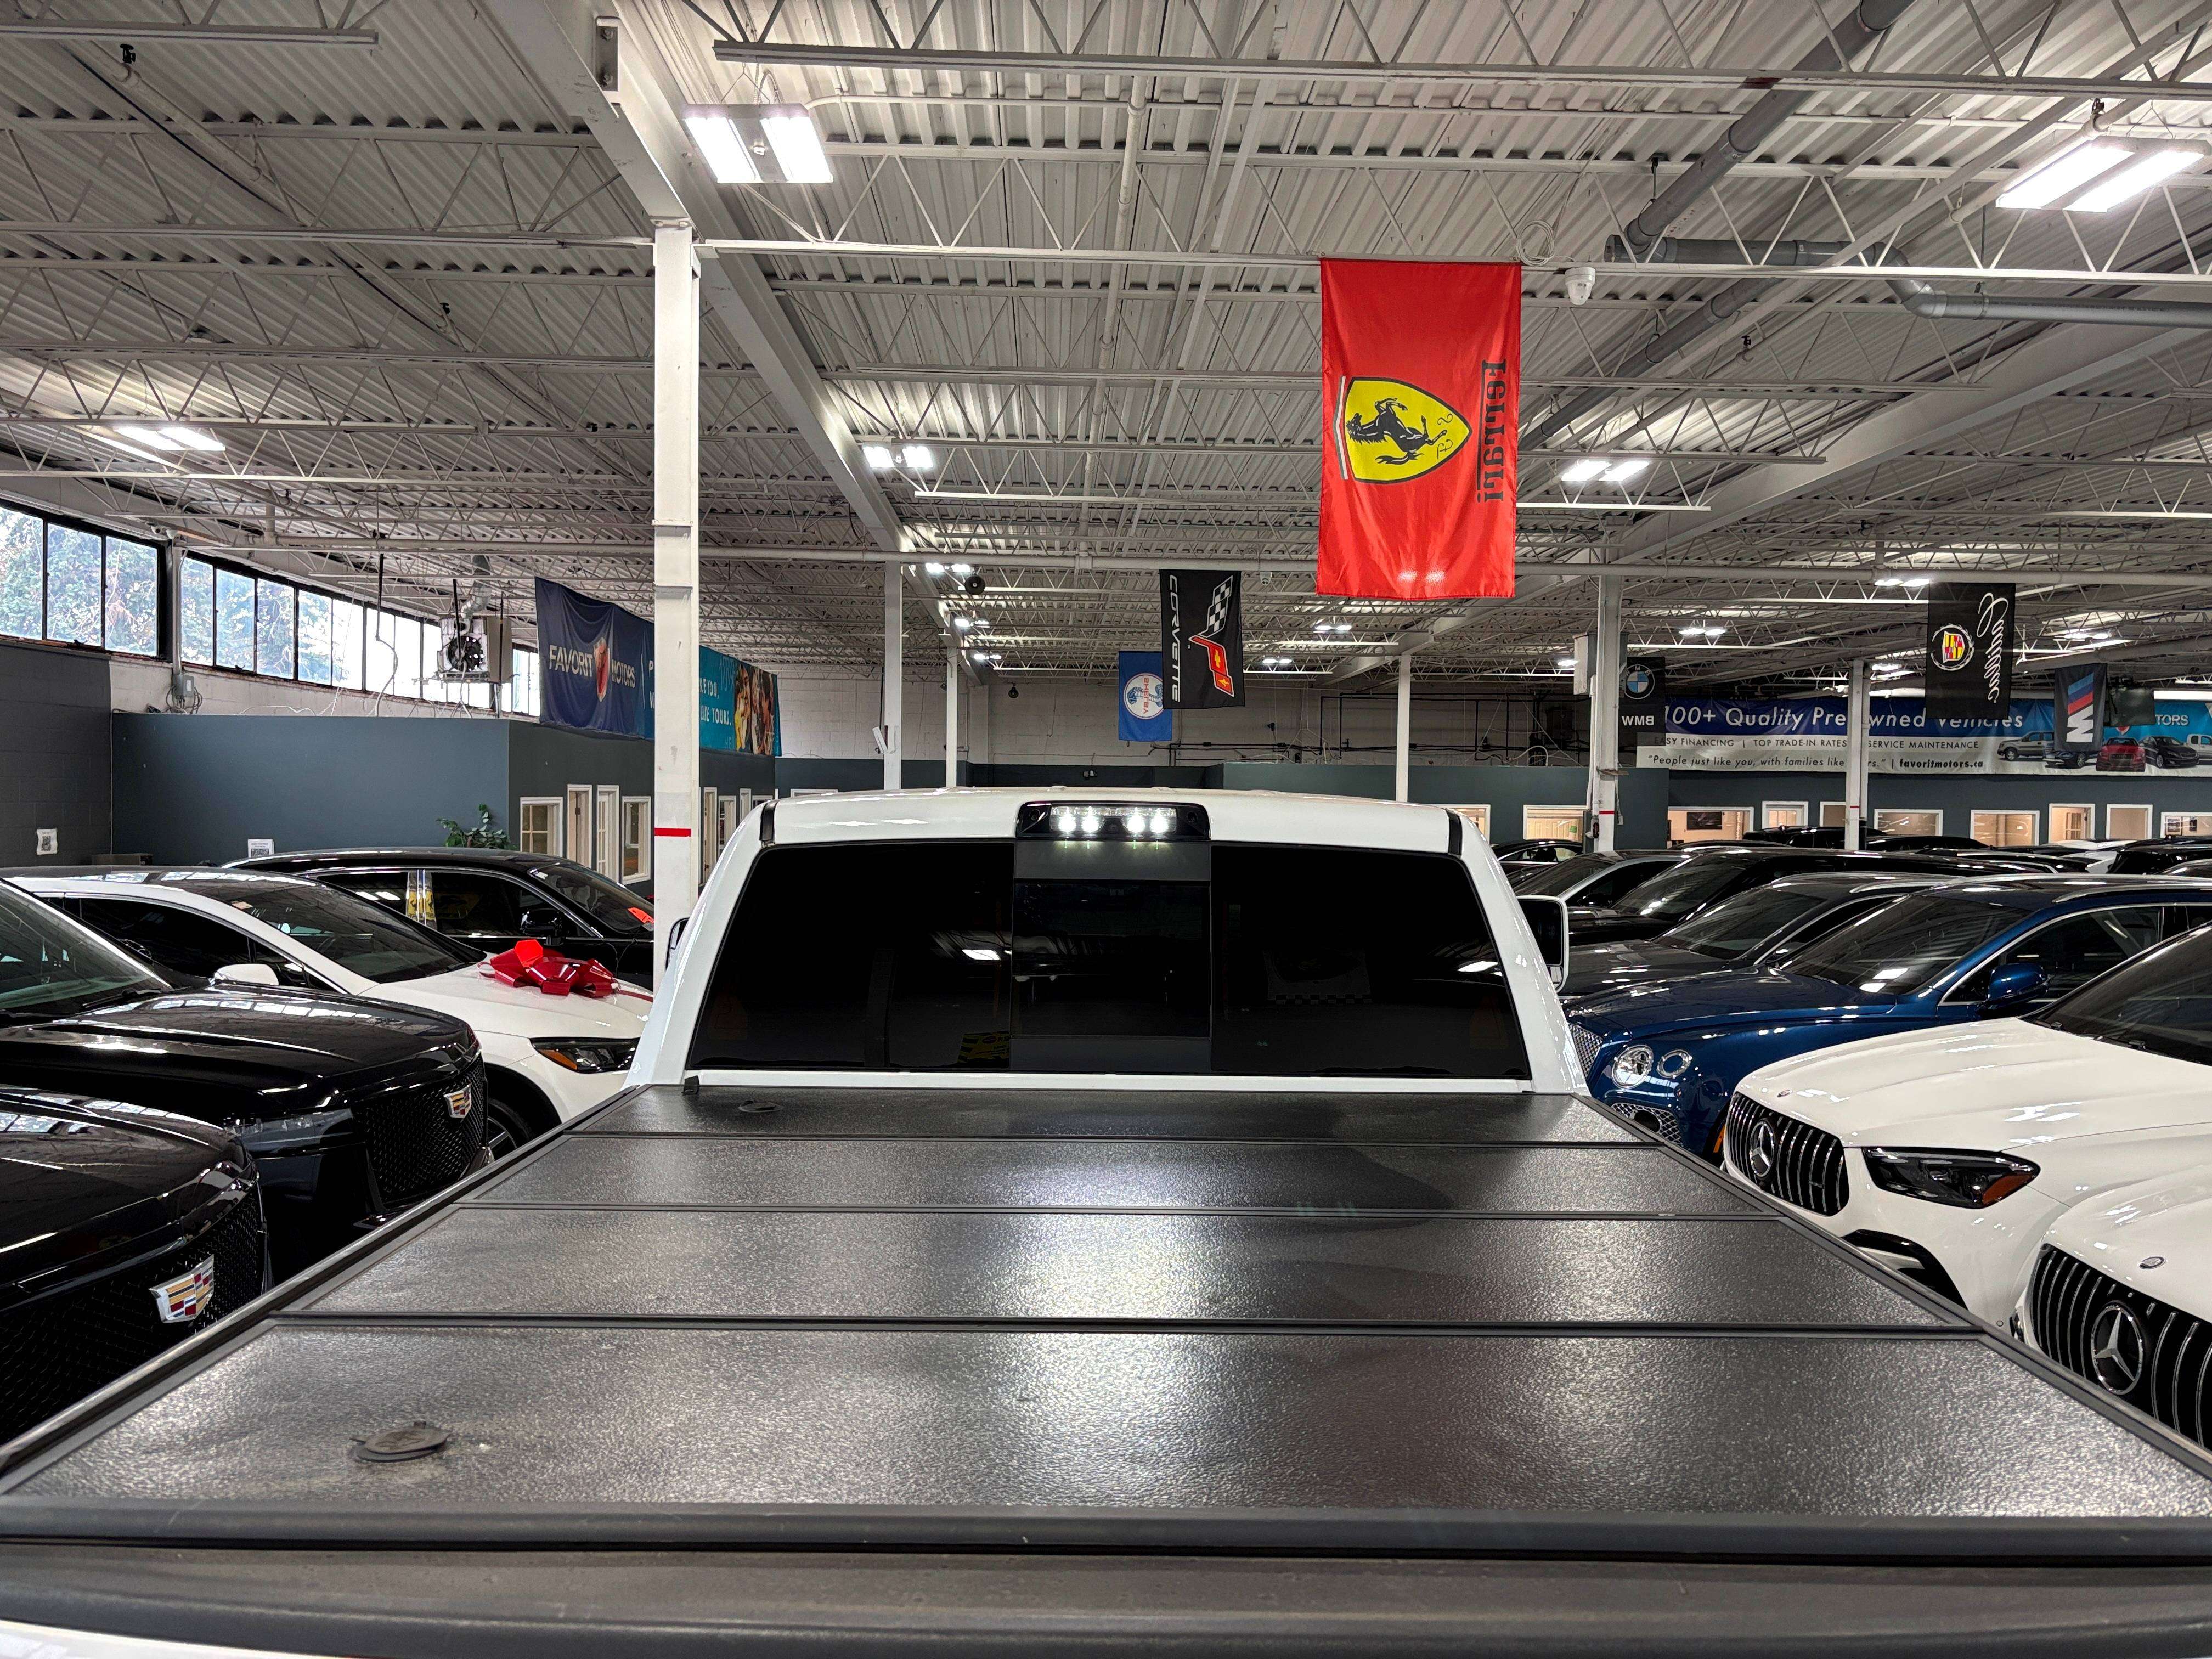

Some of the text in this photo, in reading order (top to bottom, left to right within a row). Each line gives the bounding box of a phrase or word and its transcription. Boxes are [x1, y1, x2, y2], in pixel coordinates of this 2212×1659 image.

[1170, 574, 1180, 702] CORVETTE
[549, 645, 593, 678] FAVORIT
[612, 659, 635, 688] MOTORS
[701, 705, 732, 726] LIKE YOURS.
[1726, 706, 1804, 731] Quality
[1869, 708, 1926, 728] wned
[2155, 715, 2188, 726] TORS
[1655, 737, 1677, 745] EASY
[1681, 738, 1734, 747] FINANCING
[1691, 756, 1709, 766] just
[1714, 757, 1731, 766] like
[1735, 759, 1756, 768] you,
[1761, 756, 1780, 766] with
[1785, 756, 1824, 766] families
[1827, 757, 1844, 766] like
[1899, 758, 1983, 768] favoritmotors.ca
